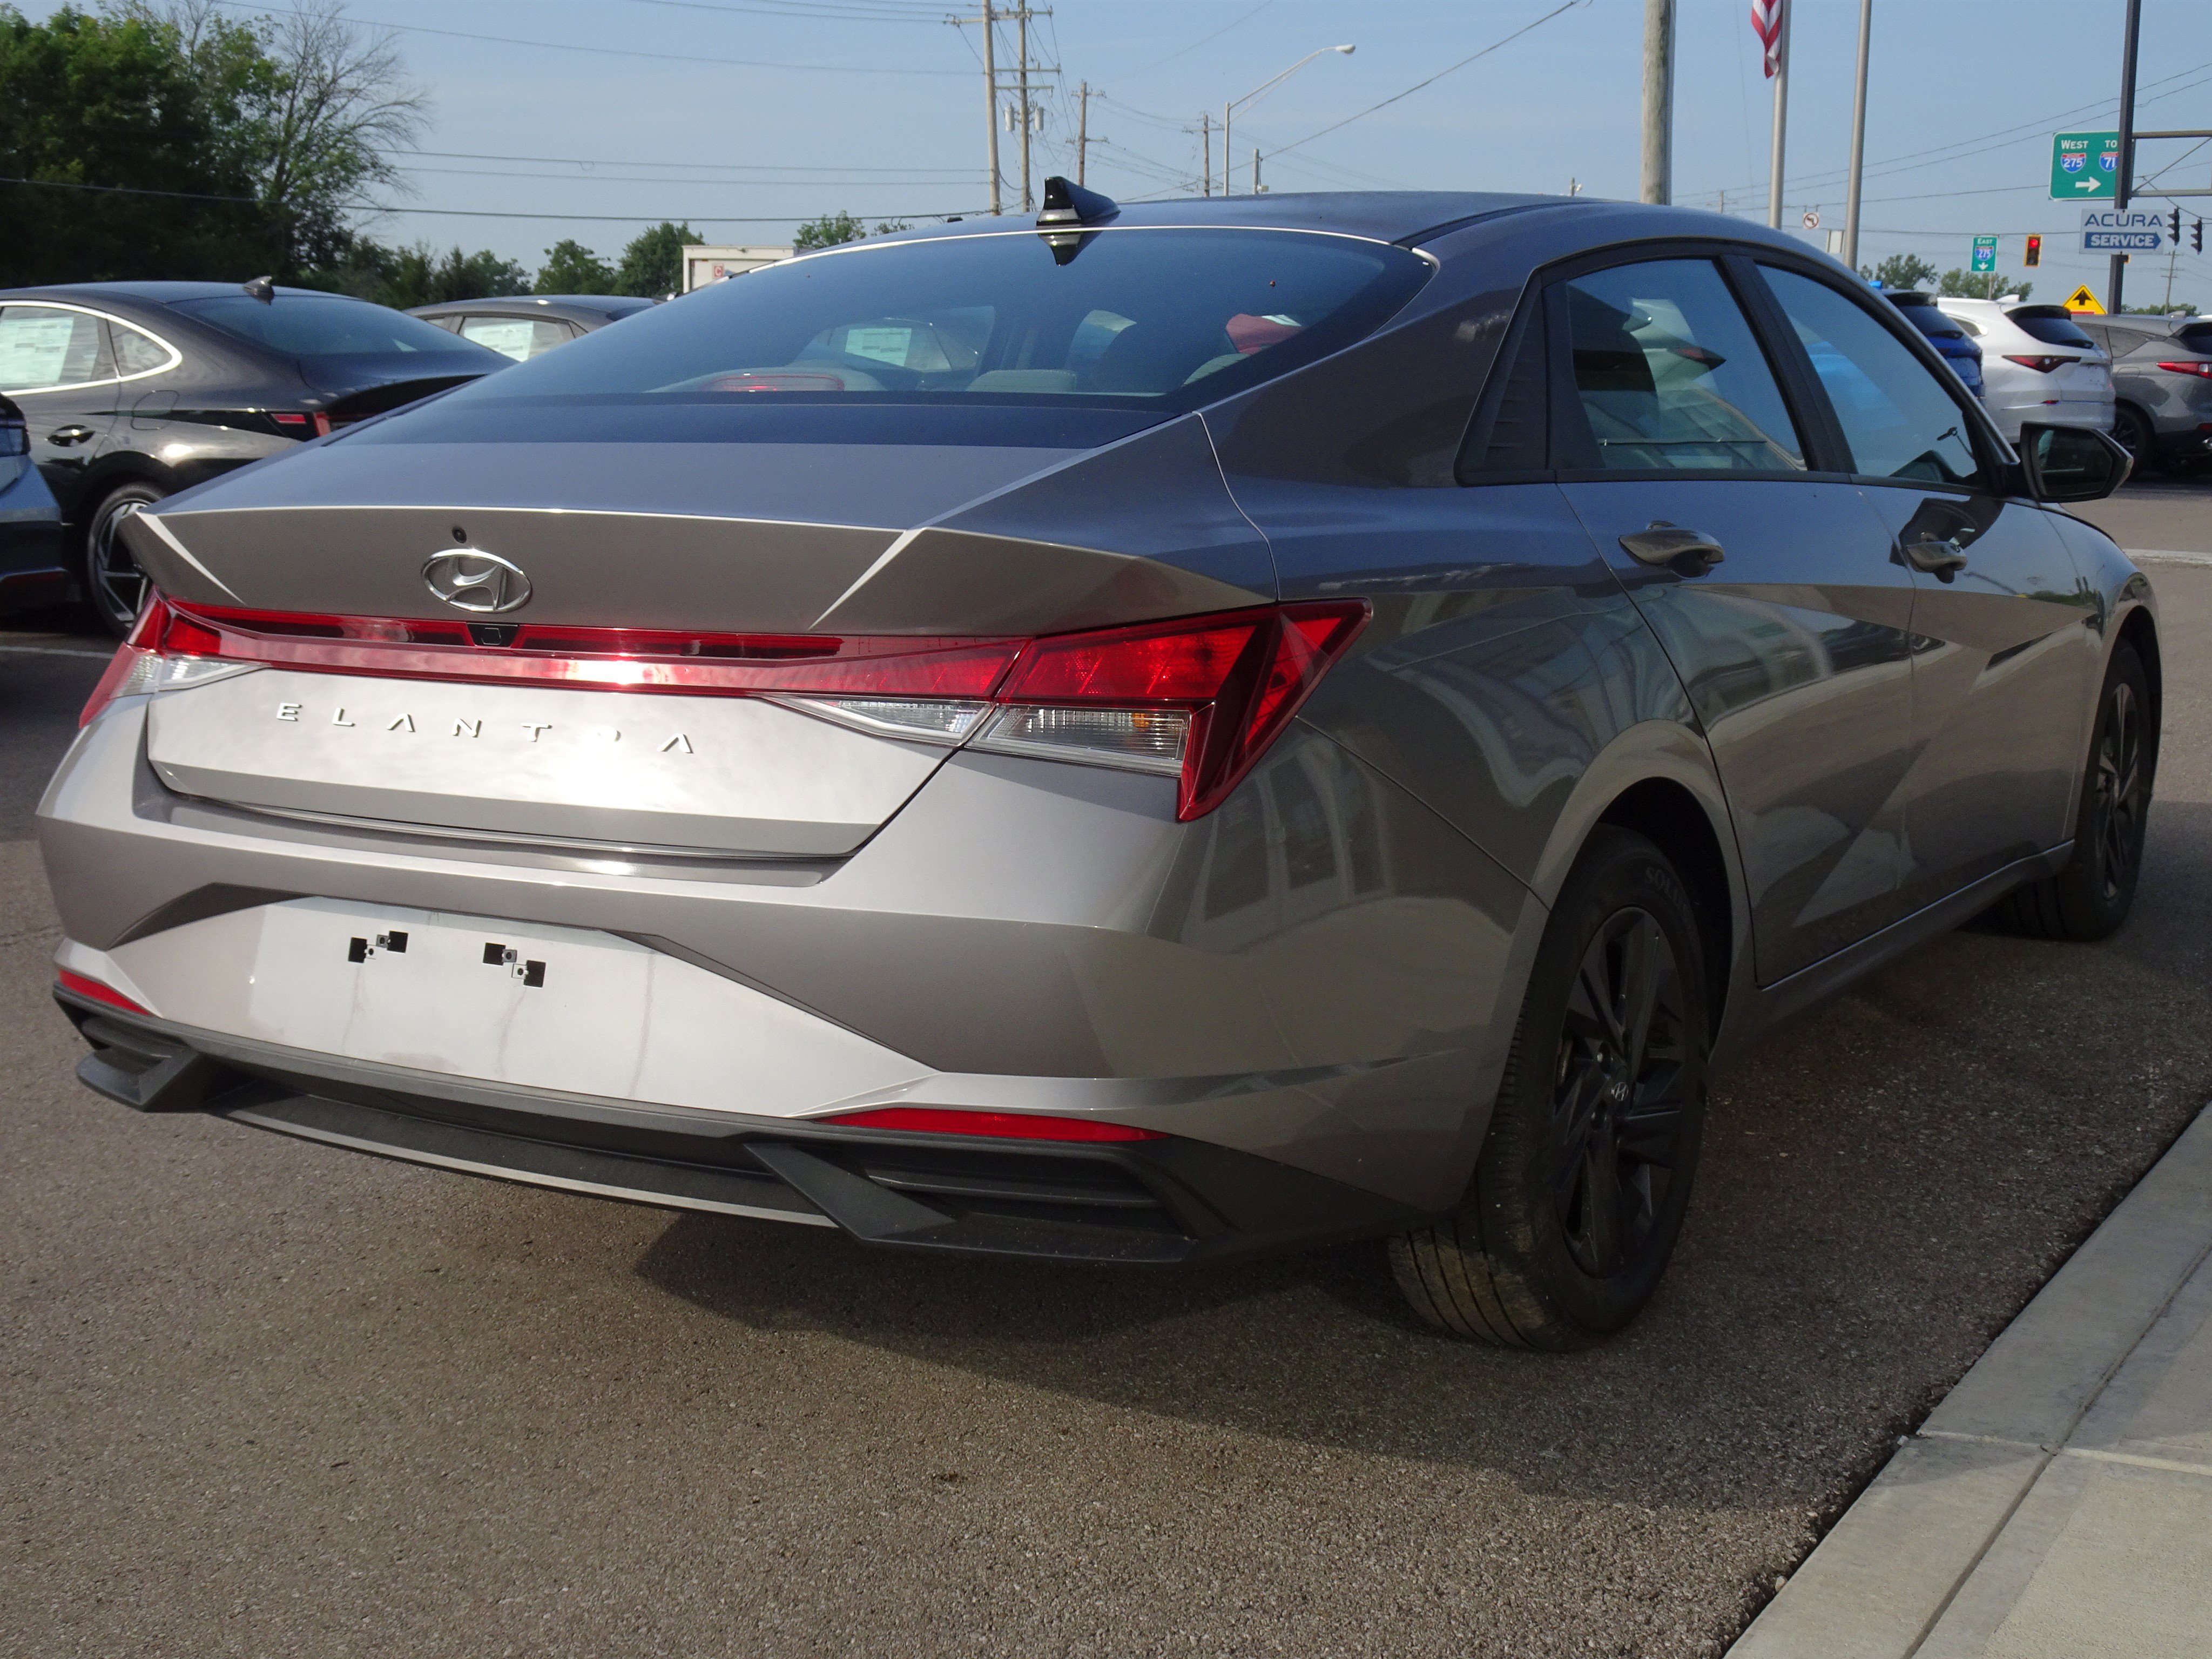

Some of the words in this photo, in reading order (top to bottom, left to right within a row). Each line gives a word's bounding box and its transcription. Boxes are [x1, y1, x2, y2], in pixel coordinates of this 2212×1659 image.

[2061, 140, 2088, 149] WEST
[2063, 158, 2083, 167] 275
[2103, 157, 2115, 168] 71
[2084, 213, 2162, 227] ACURA
[2090, 234, 2155, 247] SERVICE
[1978, 249, 1991, 258] 275
